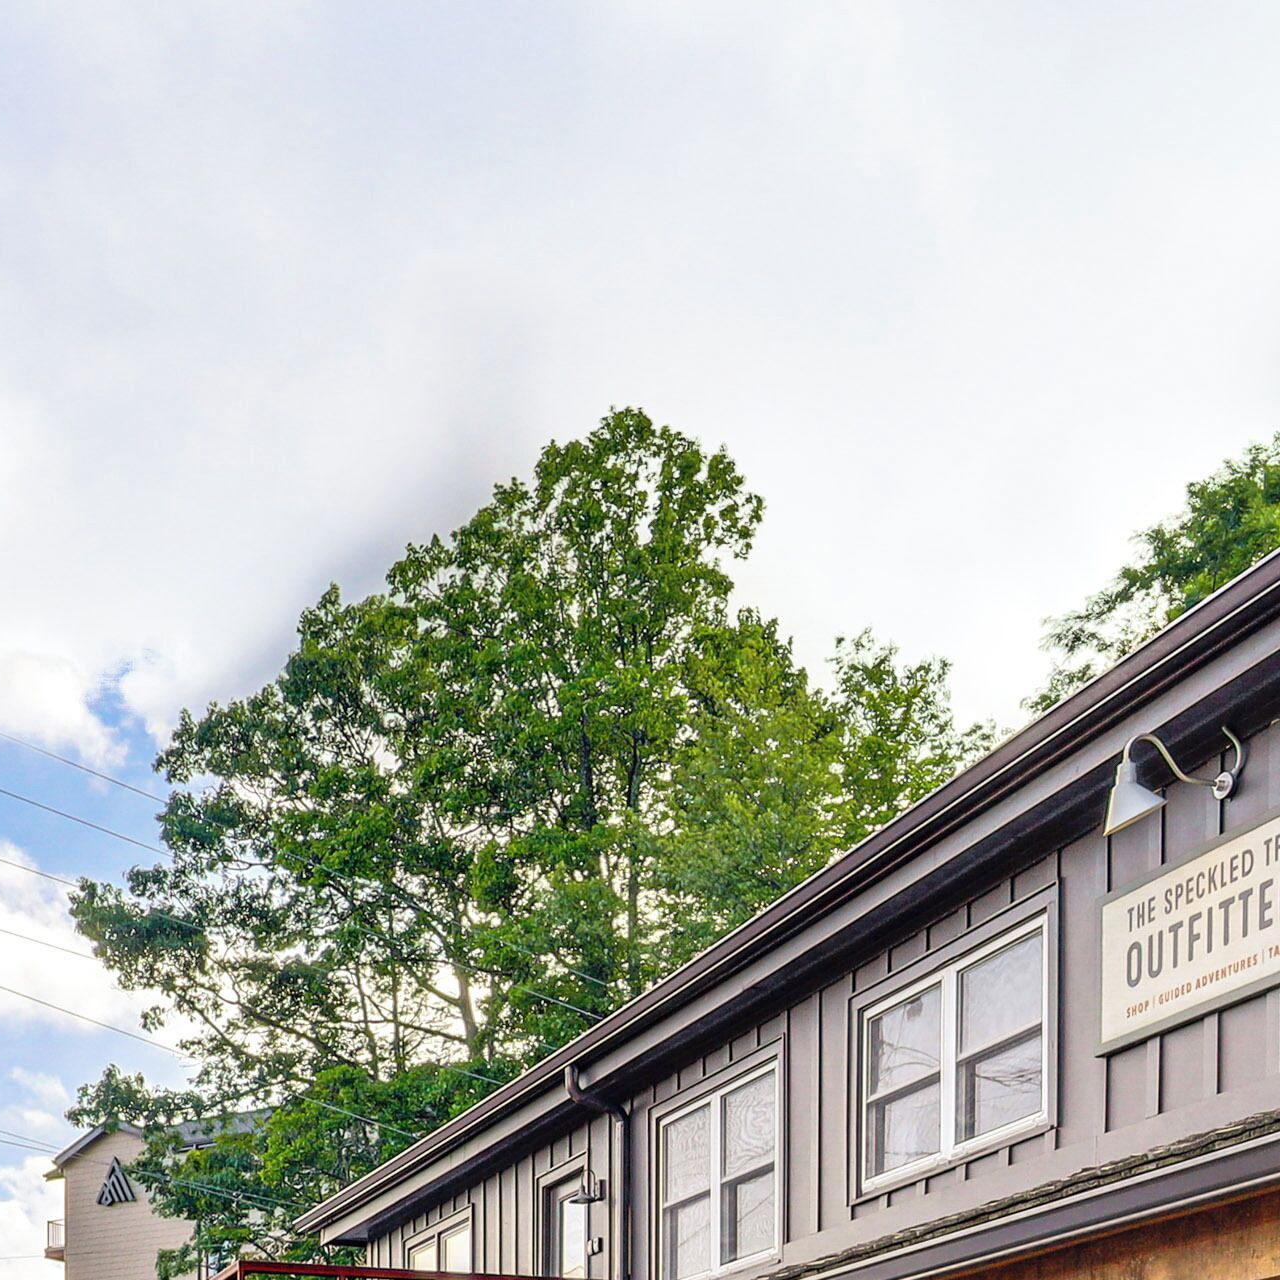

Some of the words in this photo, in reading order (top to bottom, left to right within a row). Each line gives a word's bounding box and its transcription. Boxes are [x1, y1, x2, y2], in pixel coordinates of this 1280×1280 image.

[1127, 896, 1156, 932] THE
[1164, 849, 1254, 915] SPECKLED
[1126, 1000, 1150, 1018] SHOP
[1158, 983, 1192, 1005] GUIDED
[1195, 953, 1258, 991] ADVENTURES
